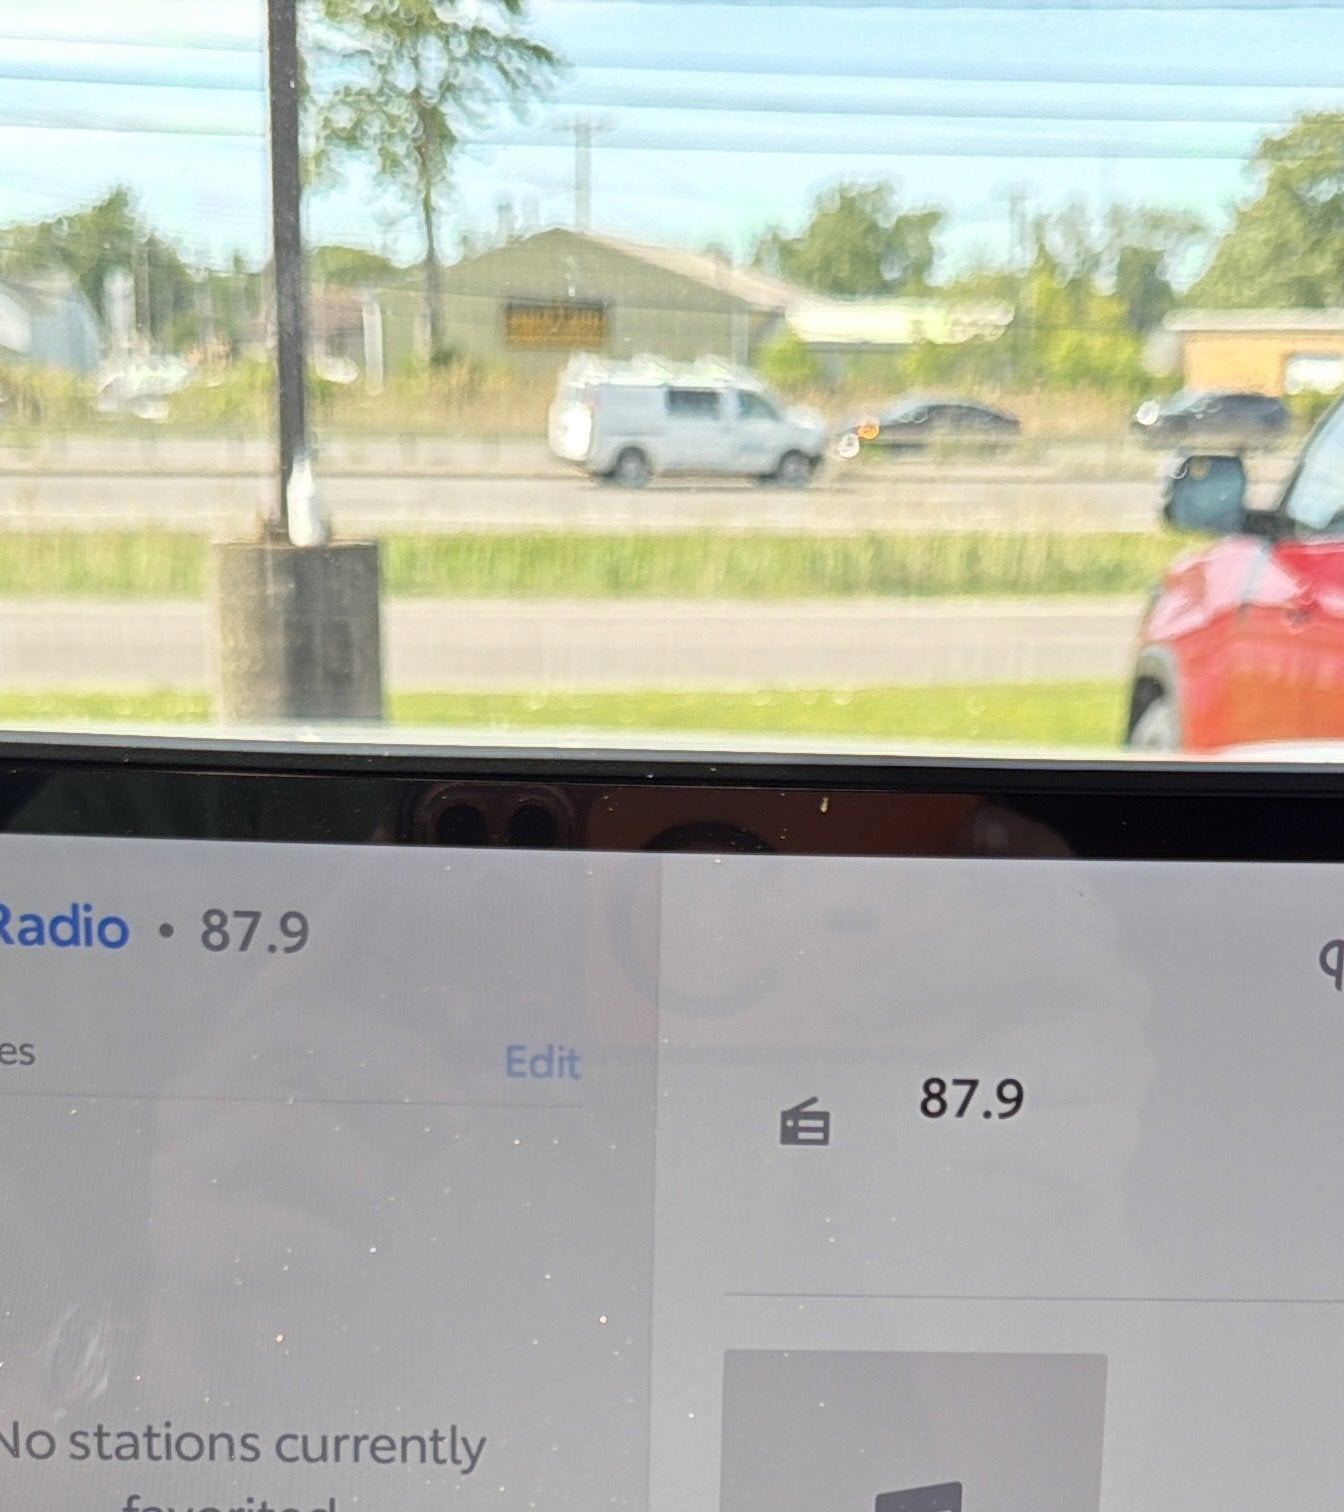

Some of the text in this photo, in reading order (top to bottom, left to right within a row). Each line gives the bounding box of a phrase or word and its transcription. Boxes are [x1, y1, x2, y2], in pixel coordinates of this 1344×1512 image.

[200, 911, 310, 955] 87.9
[505, 1045, 582, 1080] Edit
[919, 1077, 1025, 1121] 87.9
[68, 1422, 261, 1463] stations
[274, 1425, 487, 1475] currently
